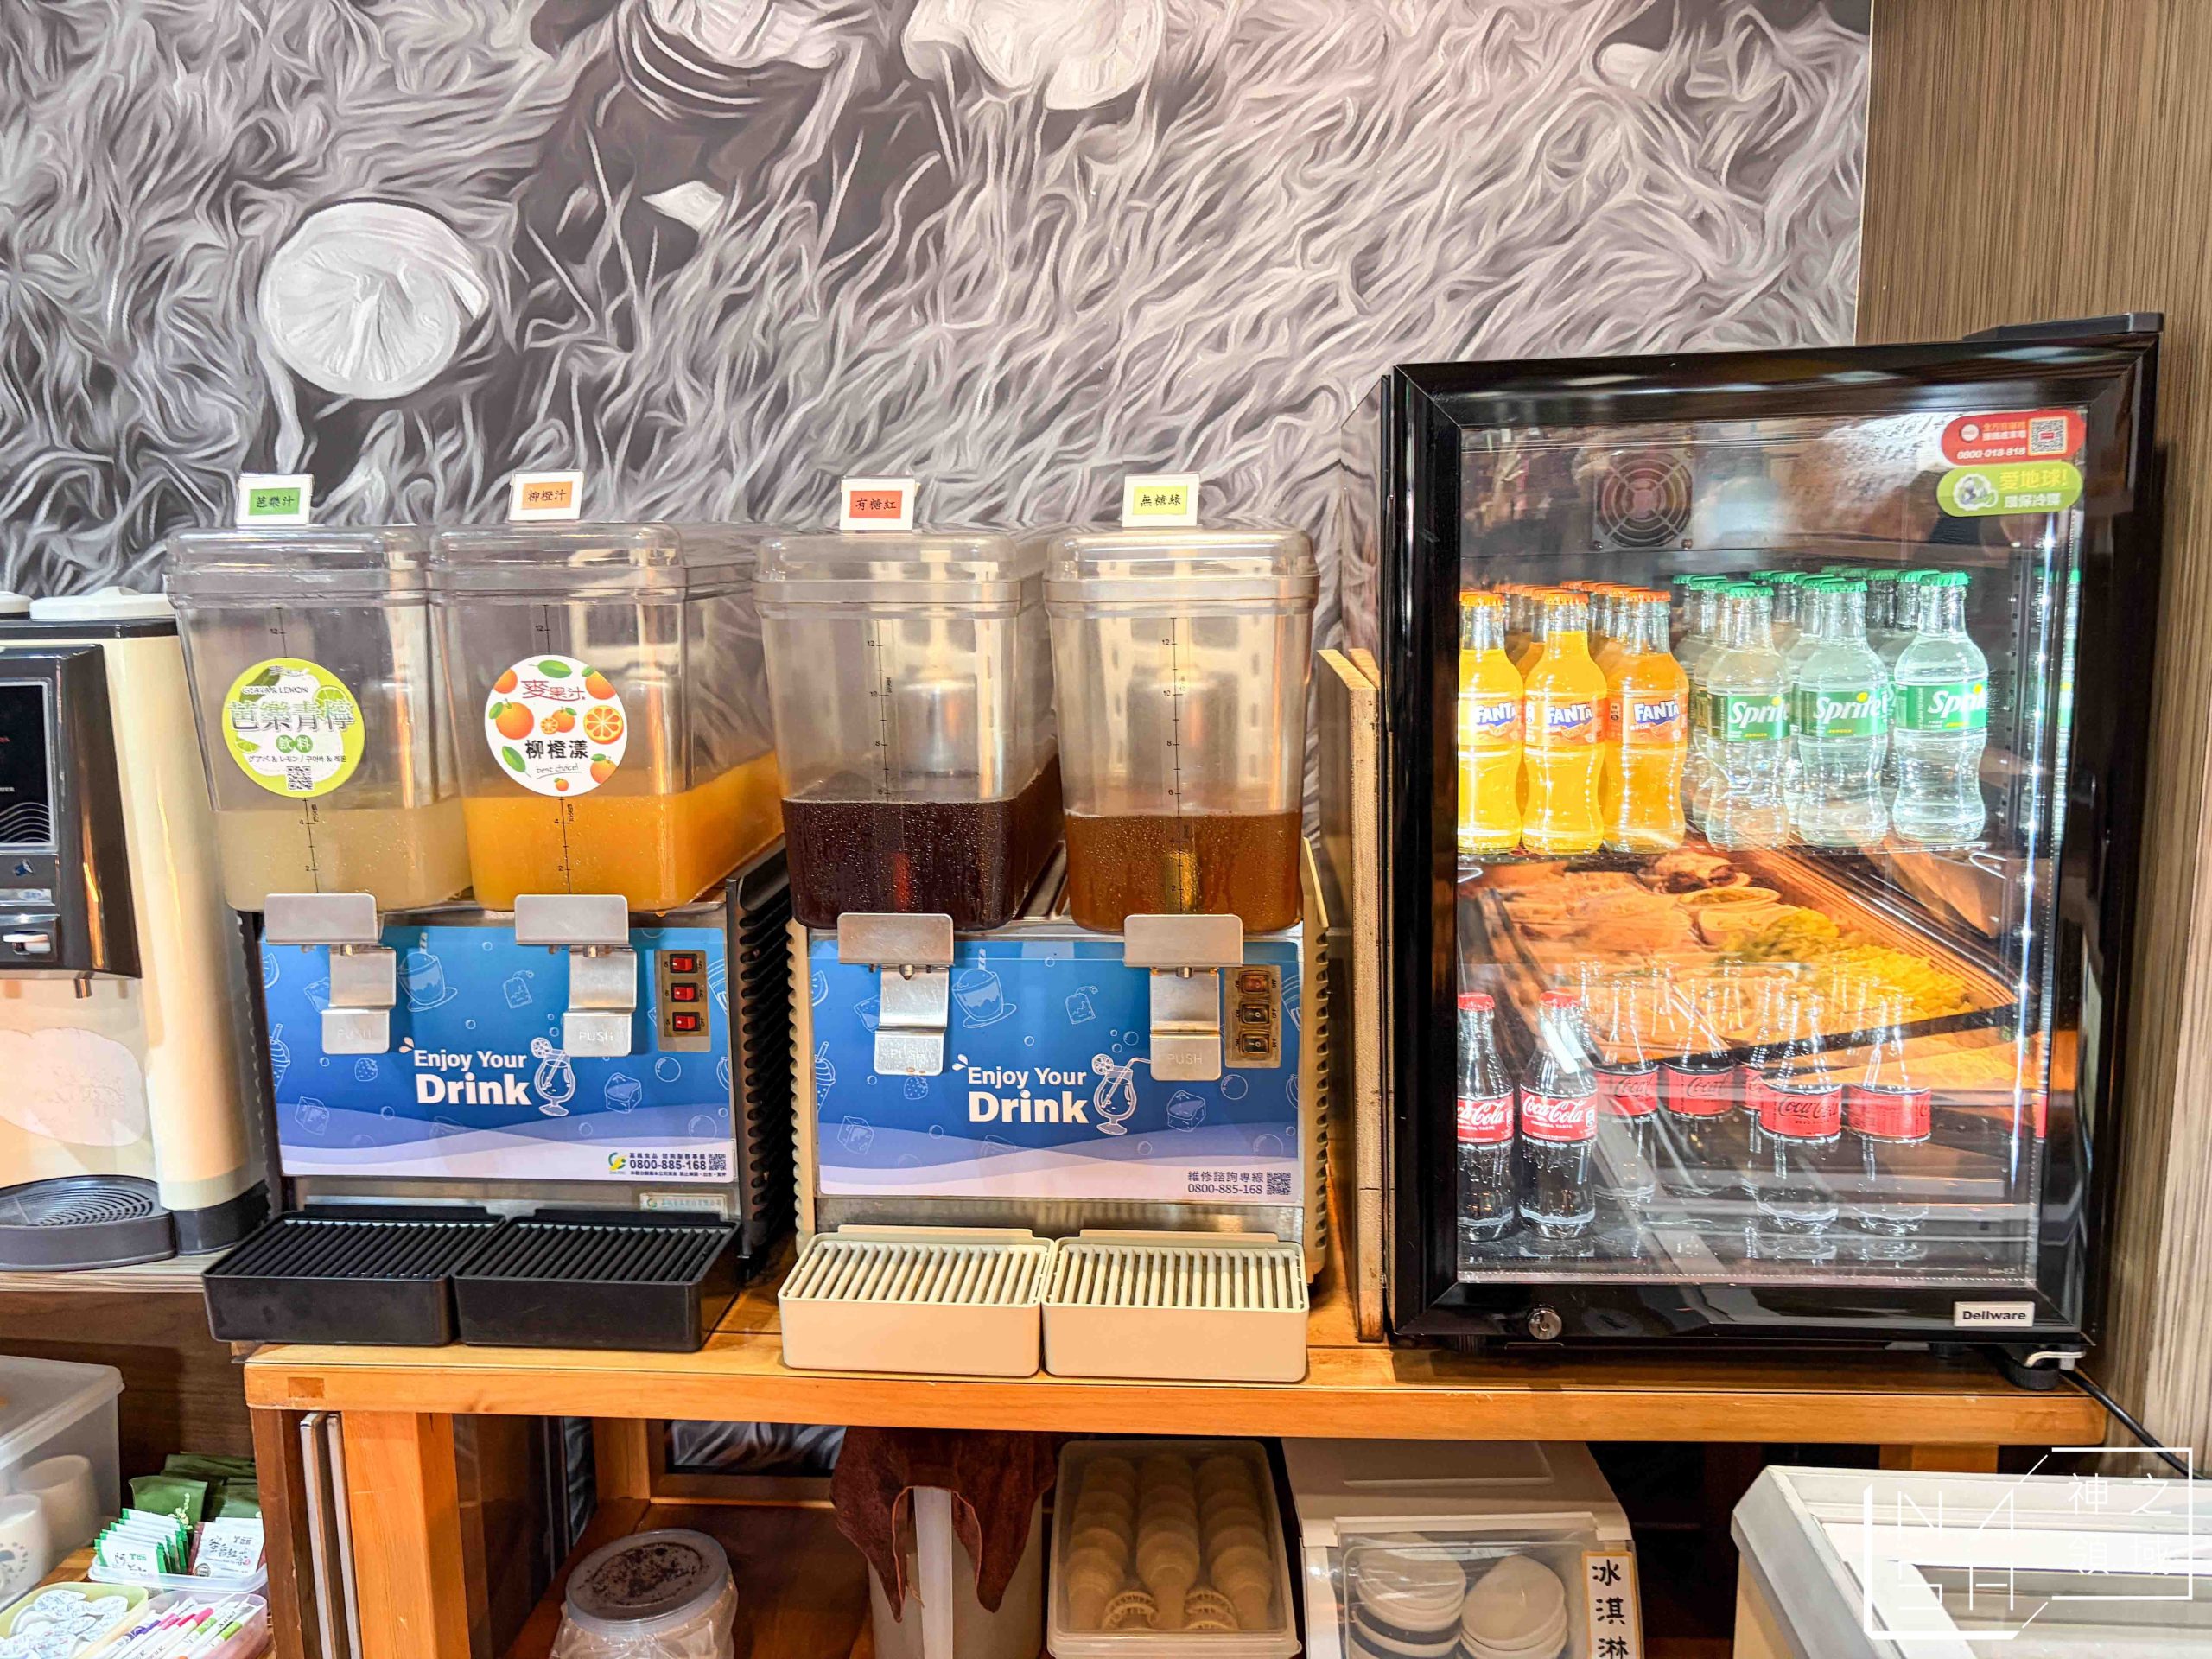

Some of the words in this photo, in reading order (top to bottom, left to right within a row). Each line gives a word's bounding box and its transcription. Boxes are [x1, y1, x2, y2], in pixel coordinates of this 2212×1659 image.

[855, 497, 897, 511] 有糖紅
[1548, 702, 1592, 727] FANTA
[1813, 692, 1881, 724] Sprite
[524, 739, 589, 760] 柳橙漾
[536, 765, 552, 774] best
[578, 1031, 614, 1042] PUSH
[414, 1049, 472, 1072] Enjoy
[476, 1050, 528, 1069] Your
[1167, 1052, 1204, 1065] PUSH
[968, 1065, 1029, 1090] Enjoy
[1034, 1067, 1088, 1085] Your
[416, 1071, 533, 1106] Drink
[968, 1089, 1090, 1124] Drink
[1522, 1095, 1586, 1124] Coca-Cola
[629, 1160, 707, 1171] 0800-885-168
[1187, 1171, 1264, 1183] 維修諮詢專線
[1187, 1183, 1263, 1195] 0800-885-168
[1962, 1310, 2026, 1320] Dellware
[1592, 1558, 1630, 1659] 冰淇淋
